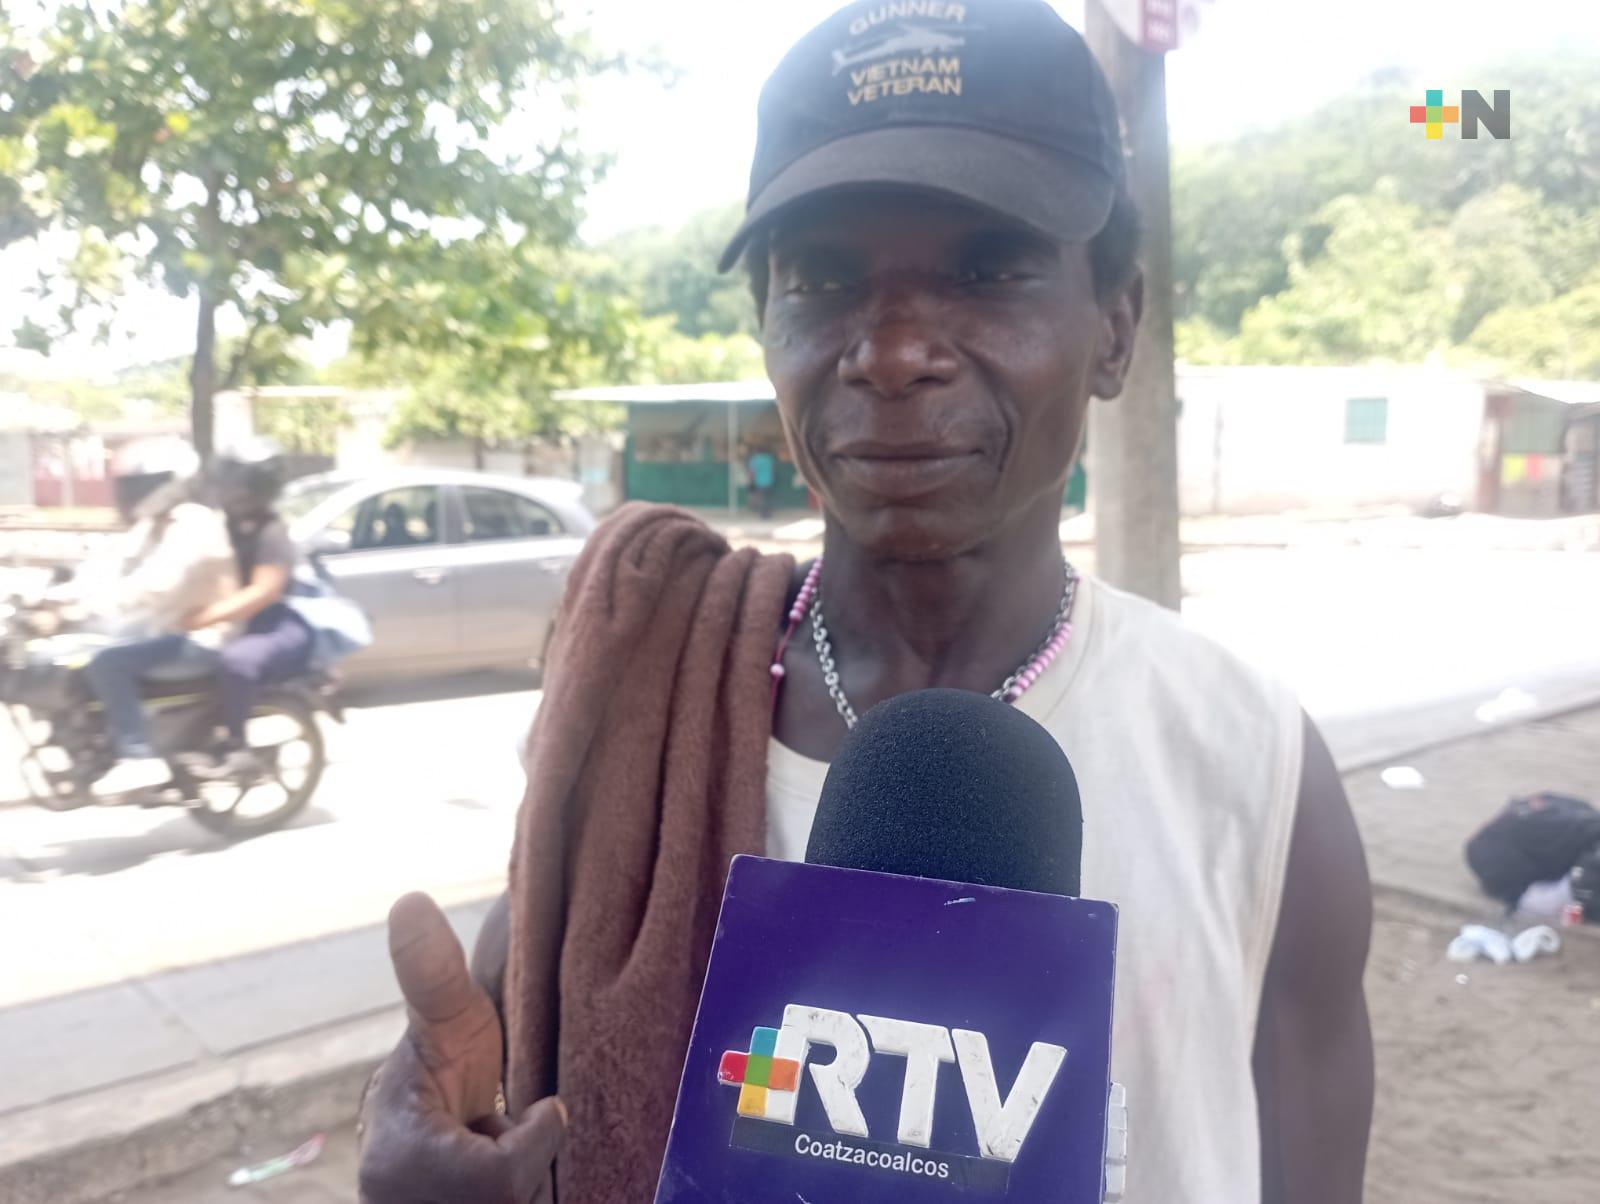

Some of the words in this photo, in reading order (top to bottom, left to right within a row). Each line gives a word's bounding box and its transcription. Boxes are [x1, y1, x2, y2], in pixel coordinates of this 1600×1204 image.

[847, 76, 963, 106] VETERAN
[766, 1003, 1068, 1162] RTV
[794, 1134, 950, 1179] Coatzacoalcos
